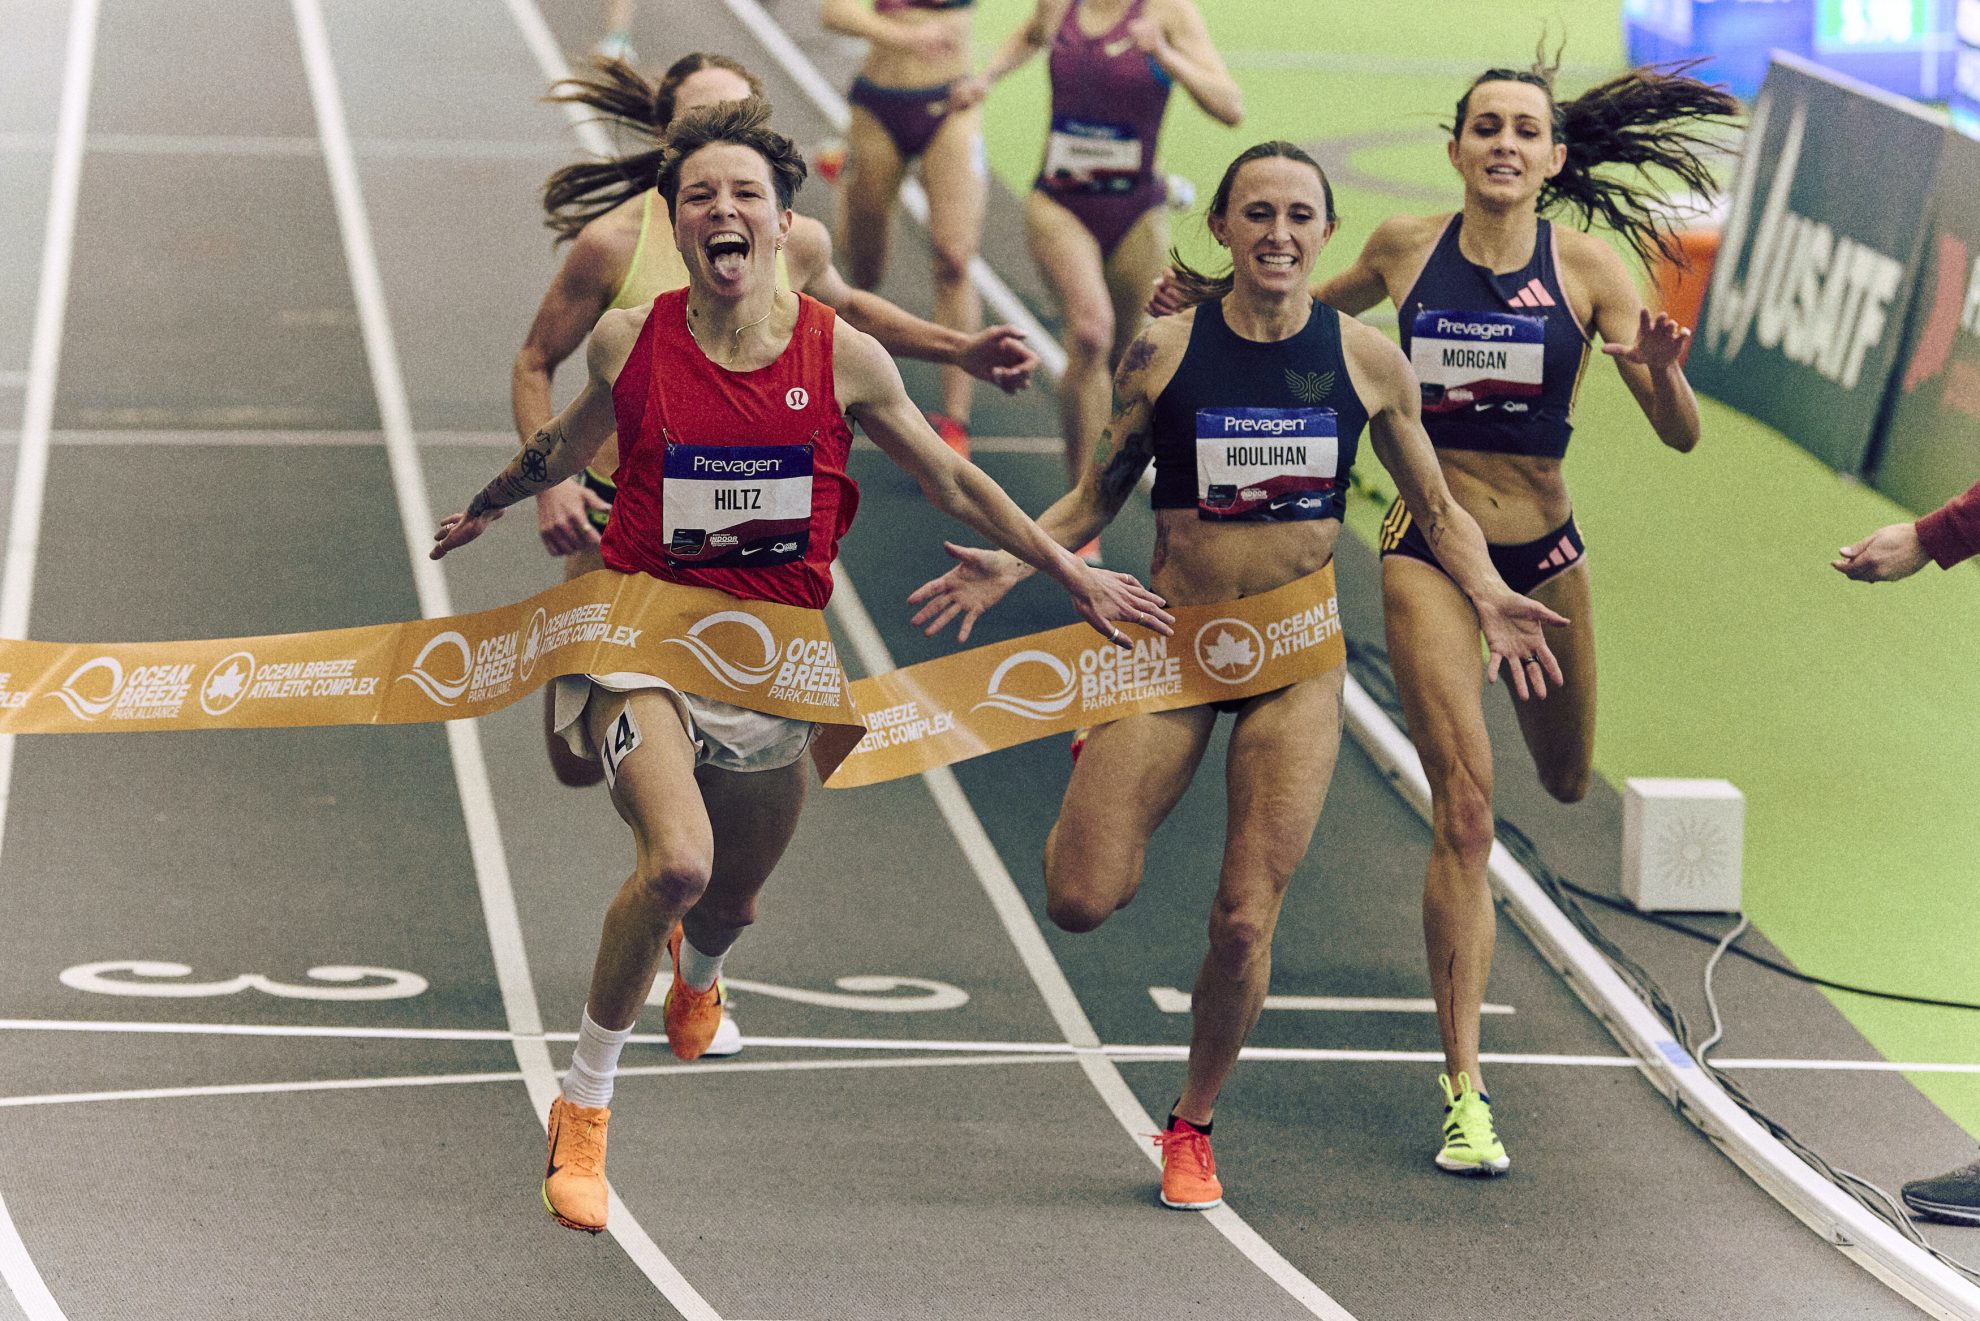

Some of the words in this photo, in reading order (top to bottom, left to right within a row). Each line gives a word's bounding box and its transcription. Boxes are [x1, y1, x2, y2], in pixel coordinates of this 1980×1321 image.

[1437, 318, 1513, 339] Prevagen
[1442, 349, 1507, 368] MORGAN
[1224, 417, 1305, 434] Prevagen
[694, 456, 780, 476] Prevagen
[1227, 447, 1306, 466] HOULIHAN
[714, 489, 761, 510] HILTZ
[545, 615, 571, 636] OCEAN
[569, 604, 611, 624] BREEZE
[1267, 603, 1325, 641] OCEAN
[476, 630, 519, 664] OCEAN
[540, 628, 574, 655] ATHLETIC
[571, 624, 643, 648] COMPLEX
[1079, 636, 1168, 674] OCEAN
[129, 664, 196, 687] OCEAN
[256, 662, 304, 680] OCEAN
[302, 659, 357, 678] BREEZE
[471, 654, 518, 690] BREEZE
[1081, 657, 1181, 699] BREEZE
[116, 684, 192, 708] BREEZE
[248, 679, 312, 698] ATHLETIC
[312, 677, 379, 696] COMPLEX
[467, 685, 488, 703] PARK
[486, 679, 513, 698] ALLIANCE
[768, 685, 803, 703] PARK
[801, 691, 841, 707] ALLIANCE
[1082, 692, 1118, 712] PARK
[1118, 681, 1183, 704] ALLIANCE
[111, 707, 137, 720] PARK
[134, 706, 181, 719] ALLIANCE
[868, 701, 919, 731] BREEZE
[889, 710, 954, 746] COMPLEX
